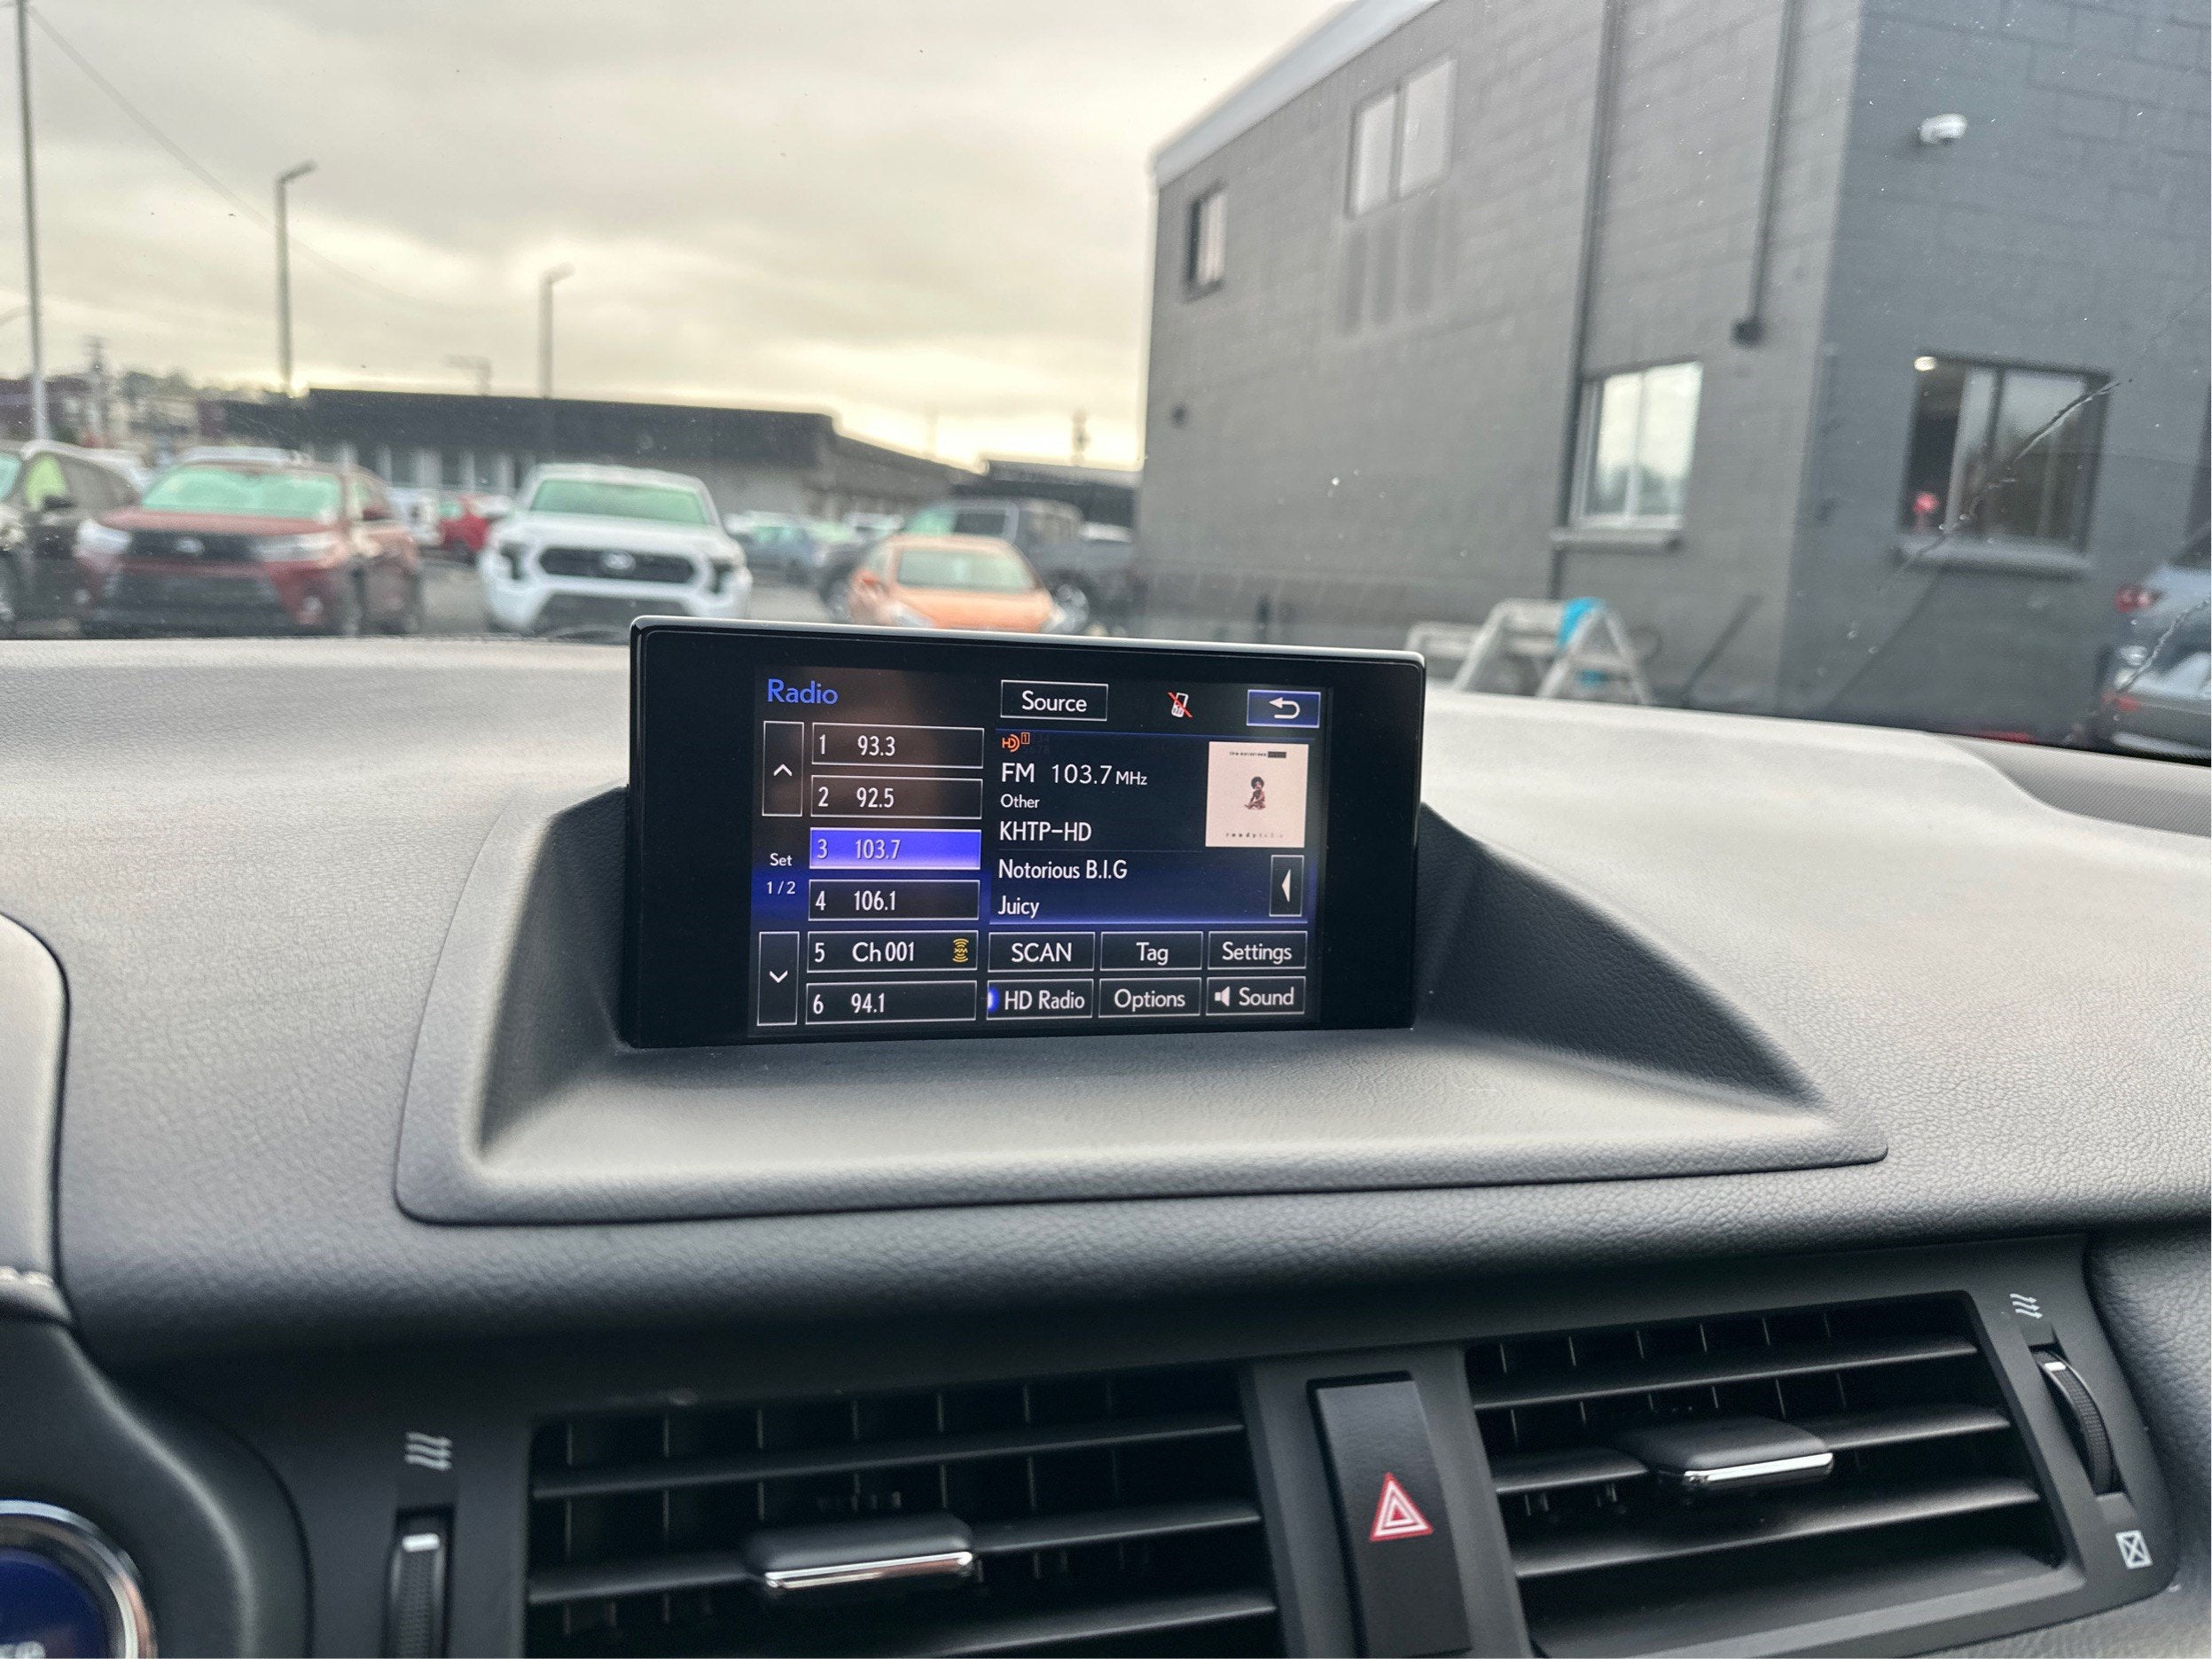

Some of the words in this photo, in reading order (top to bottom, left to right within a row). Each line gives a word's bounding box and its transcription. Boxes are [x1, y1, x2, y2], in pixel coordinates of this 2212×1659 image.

[767, 678, 839, 705] Radio
[1021, 690, 1088, 712] Source
[819, 734, 826, 755] 1
[857, 735, 896, 756] 93.3
[1001, 763, 1036, 783] FM
[1051, 764, 1113, 785] 103.7
[1115, 771, 1148, 786] MHz
[818, 786, 829, 807] 2
[856, 786, 895, 808] 92.5
[1000, 794, 1040, 809] Other
[1000, 821, 1092, 841] KHTP-HD
[770, 853, 793, 866] Set
[817, 839, 828, 859] 3
[856, 839, 901, 859] 103.7
[998, 859, 1080, 880] Notorious
[1086, 859, 1128, 880] B.I.G
[815, 891, 826, 911] 4
[854, 890, 896, 911] 106.1
[998, 895, 1040, 919] Juicy
[814, 943, 825, 963] 5
[1012, 943, 1073, 963] SCAN
[1136, 942, 1169, 966] Tag
[1222, 942, 1293, 964] Settings
[813, 994, 824, 1014] 6
[851, 993, 886, 1013] 94.1
[1004, 990, 1033, 1011] HD
[1039, 990, 1085, 1010] Radio
[1114, 988, 1186, 1012] Options
[1239, 986, 1294, 1006] Sound
